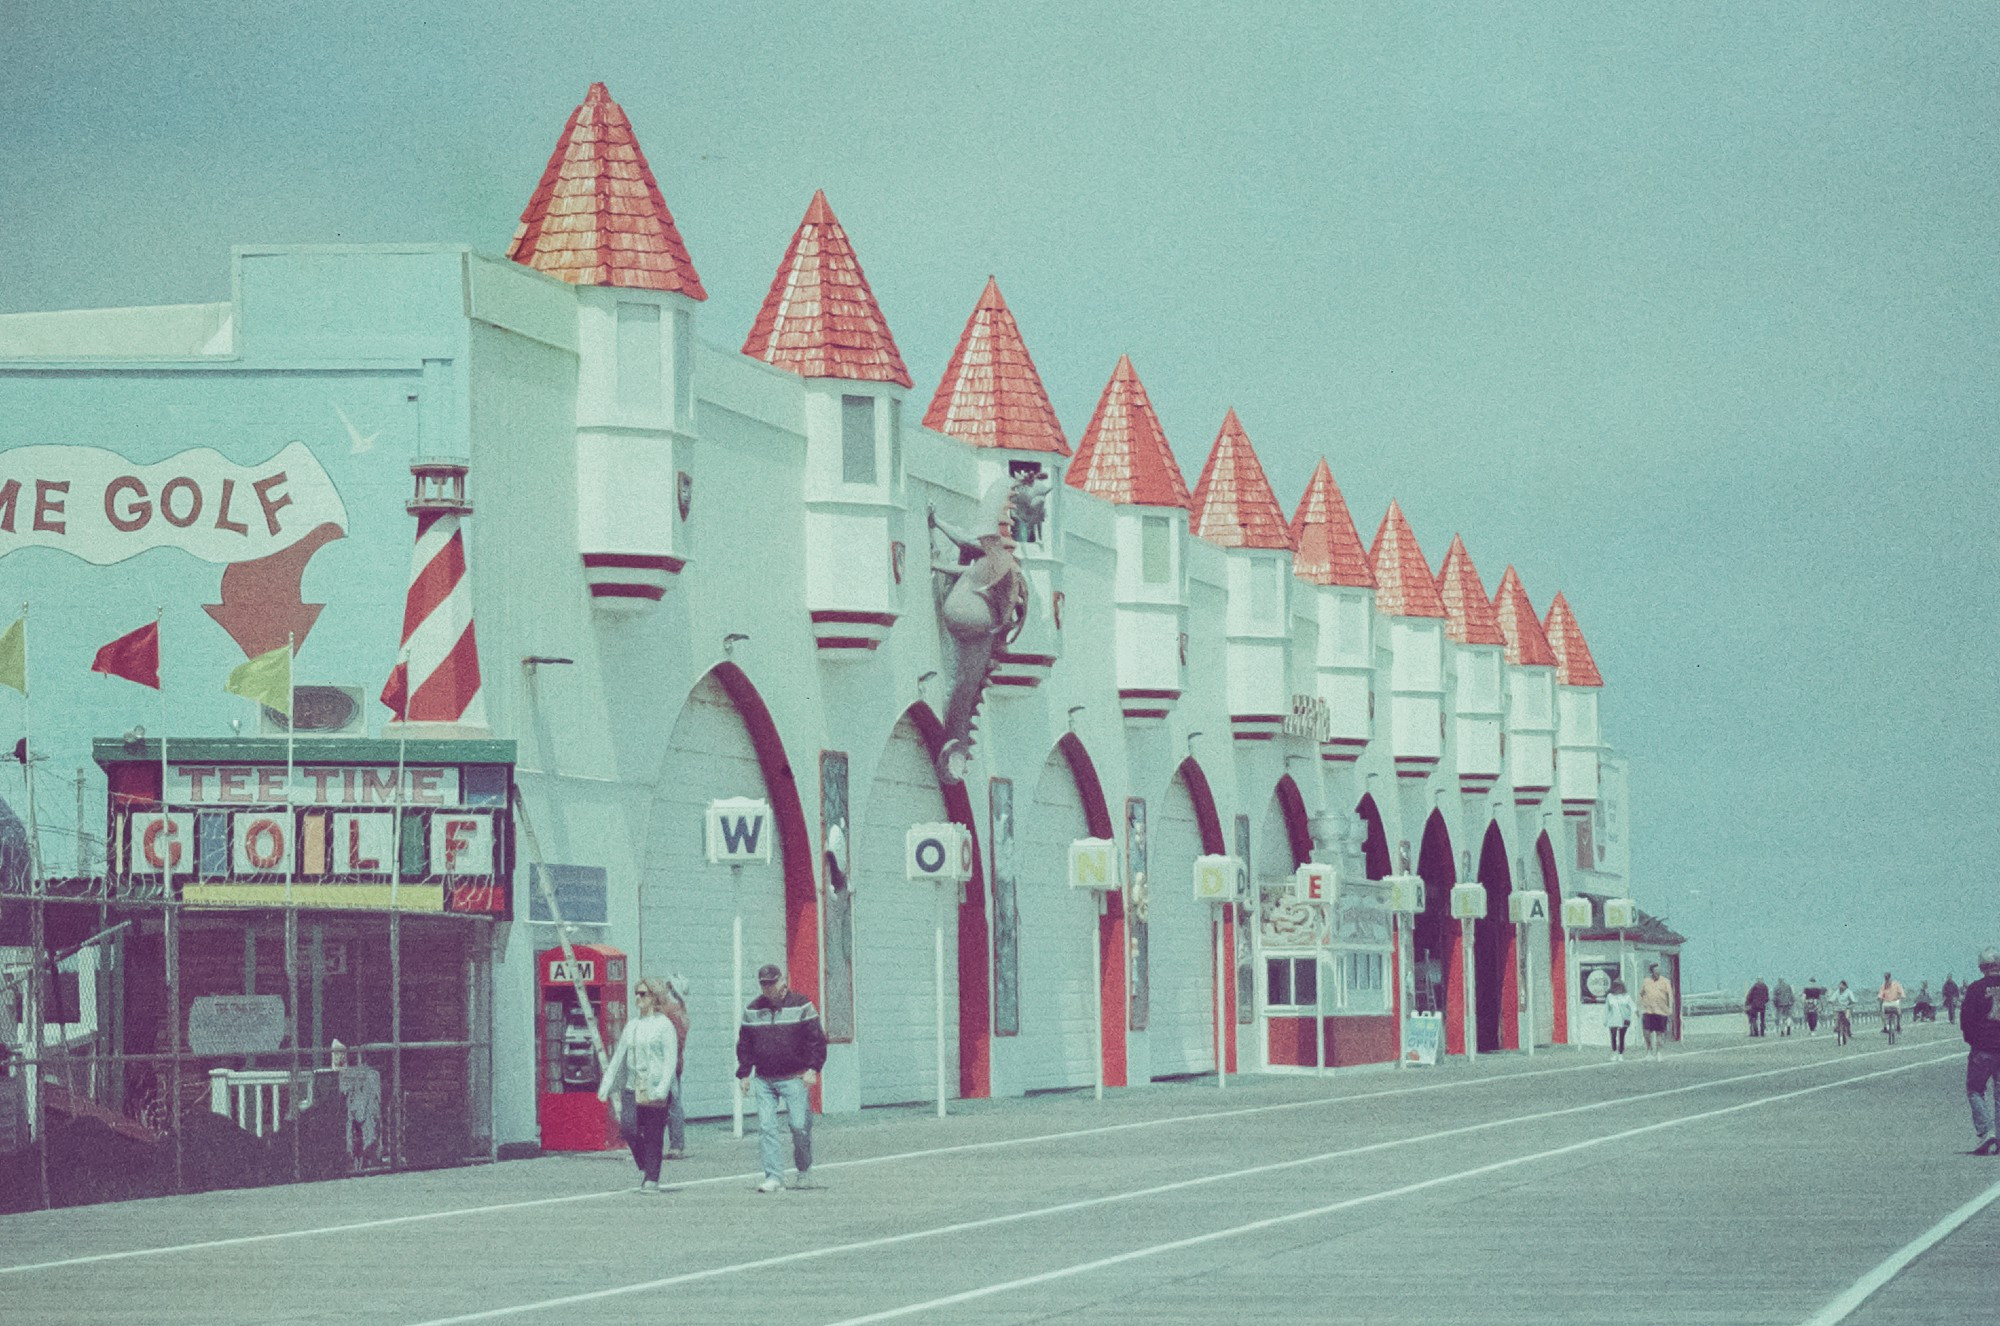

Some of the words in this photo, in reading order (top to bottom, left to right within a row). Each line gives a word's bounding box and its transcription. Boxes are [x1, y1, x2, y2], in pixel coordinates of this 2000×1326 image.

[104, 471, 293, 537] GOLF
[178, 767, 290, 803] TEE
[303, 767, 445, 804] TIME
